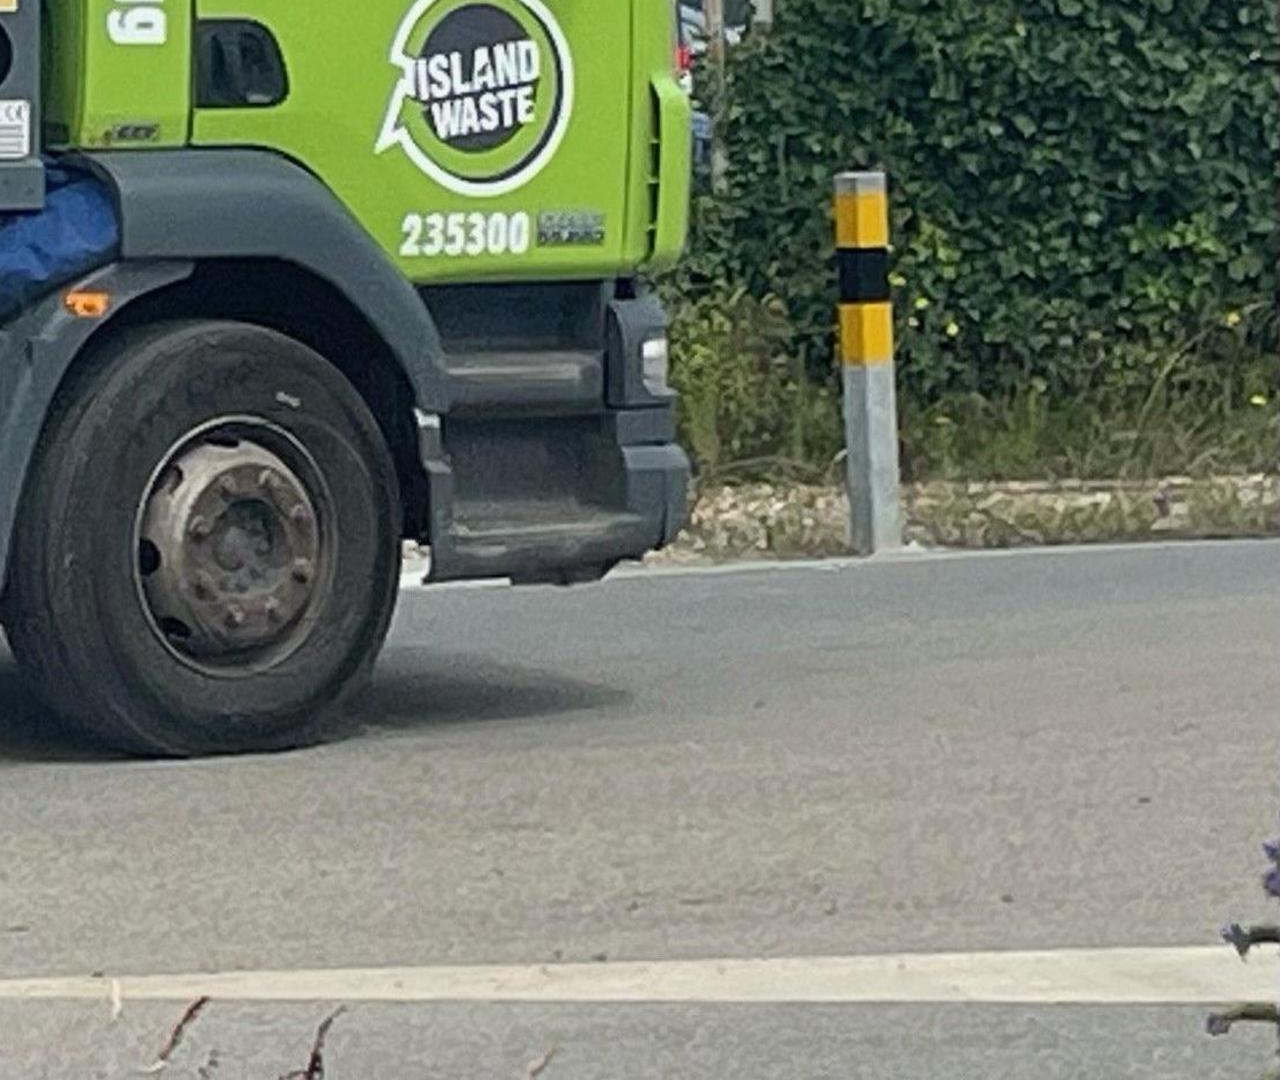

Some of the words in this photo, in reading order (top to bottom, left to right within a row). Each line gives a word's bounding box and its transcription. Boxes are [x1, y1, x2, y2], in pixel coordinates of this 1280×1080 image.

[417, 39, 540, 102] ISLAND
[430, 86, 536, 140] WASTE
[399, 211, 531, 257] 235300
